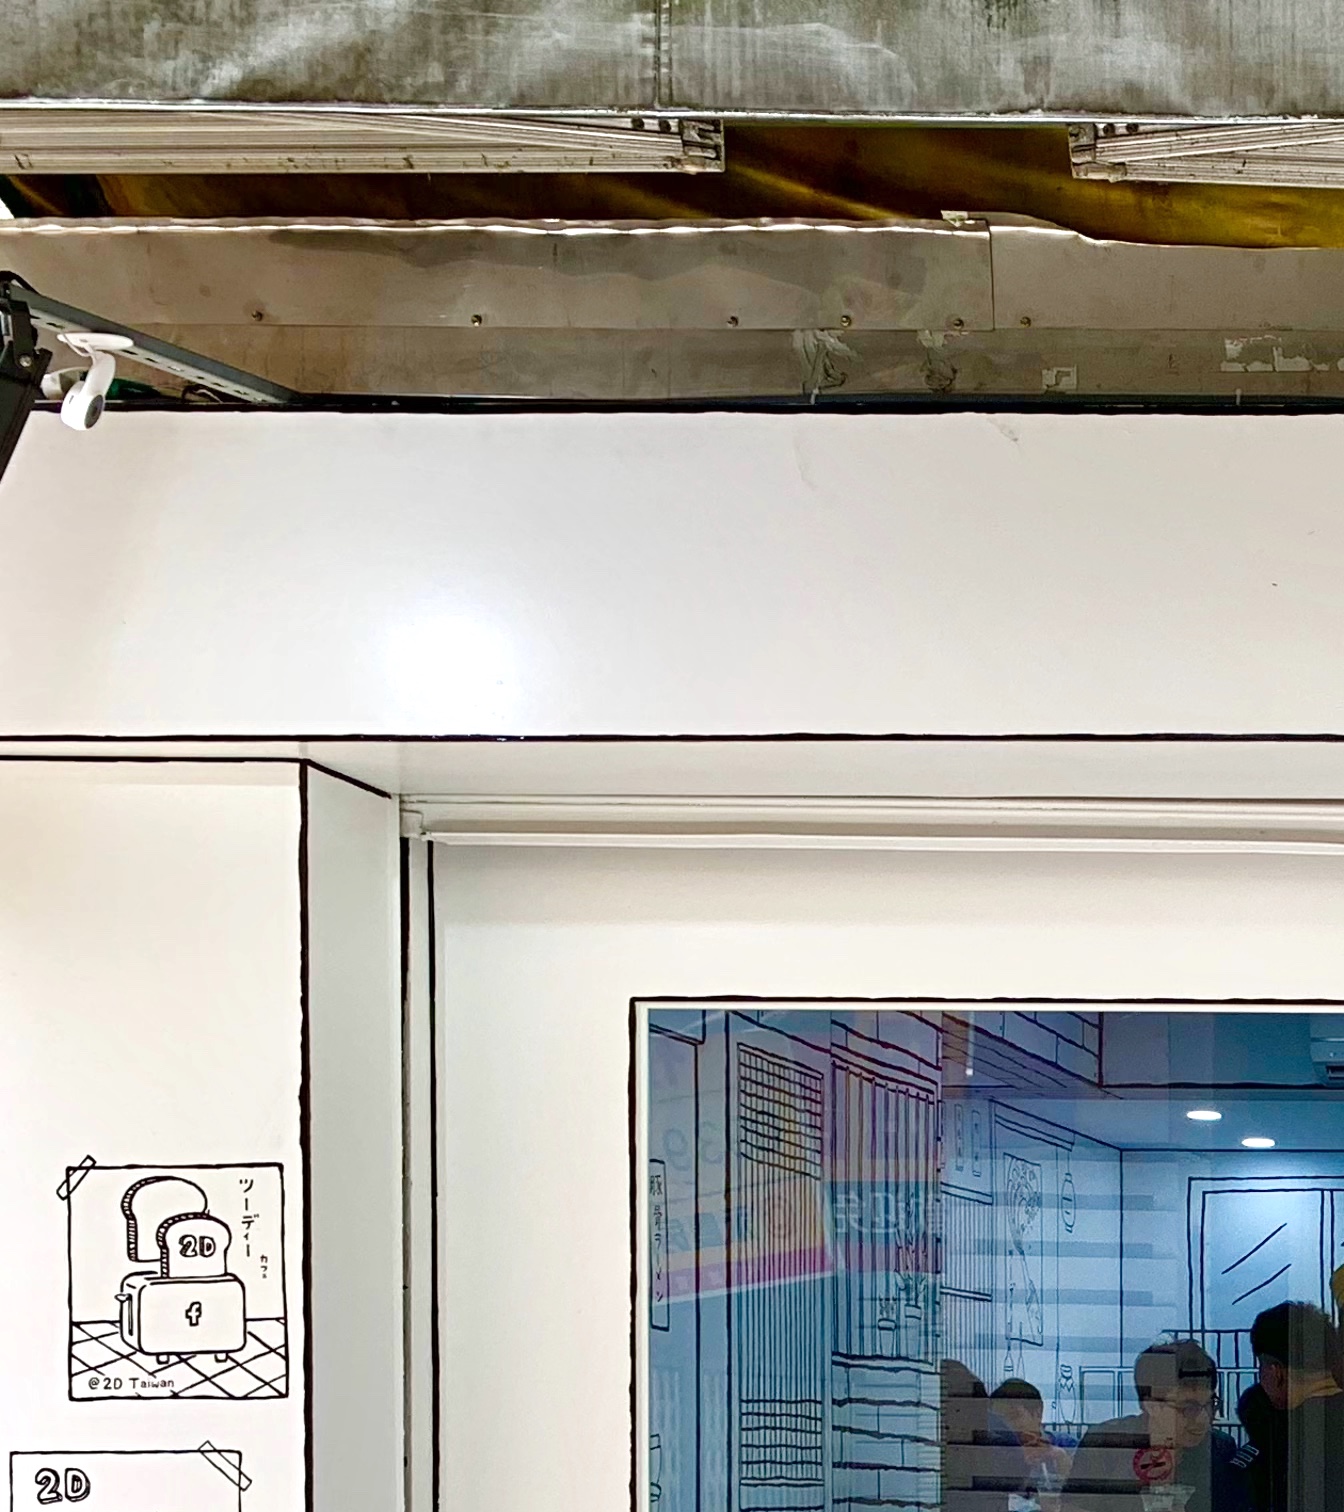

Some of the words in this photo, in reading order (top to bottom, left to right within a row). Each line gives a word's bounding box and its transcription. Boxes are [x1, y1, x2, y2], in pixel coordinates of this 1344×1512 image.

[179, 1234, 216, 1258] 2D
[128, 1377, 174, 1389] Taiwan
[35, 1468, 91, 1505] 2D
